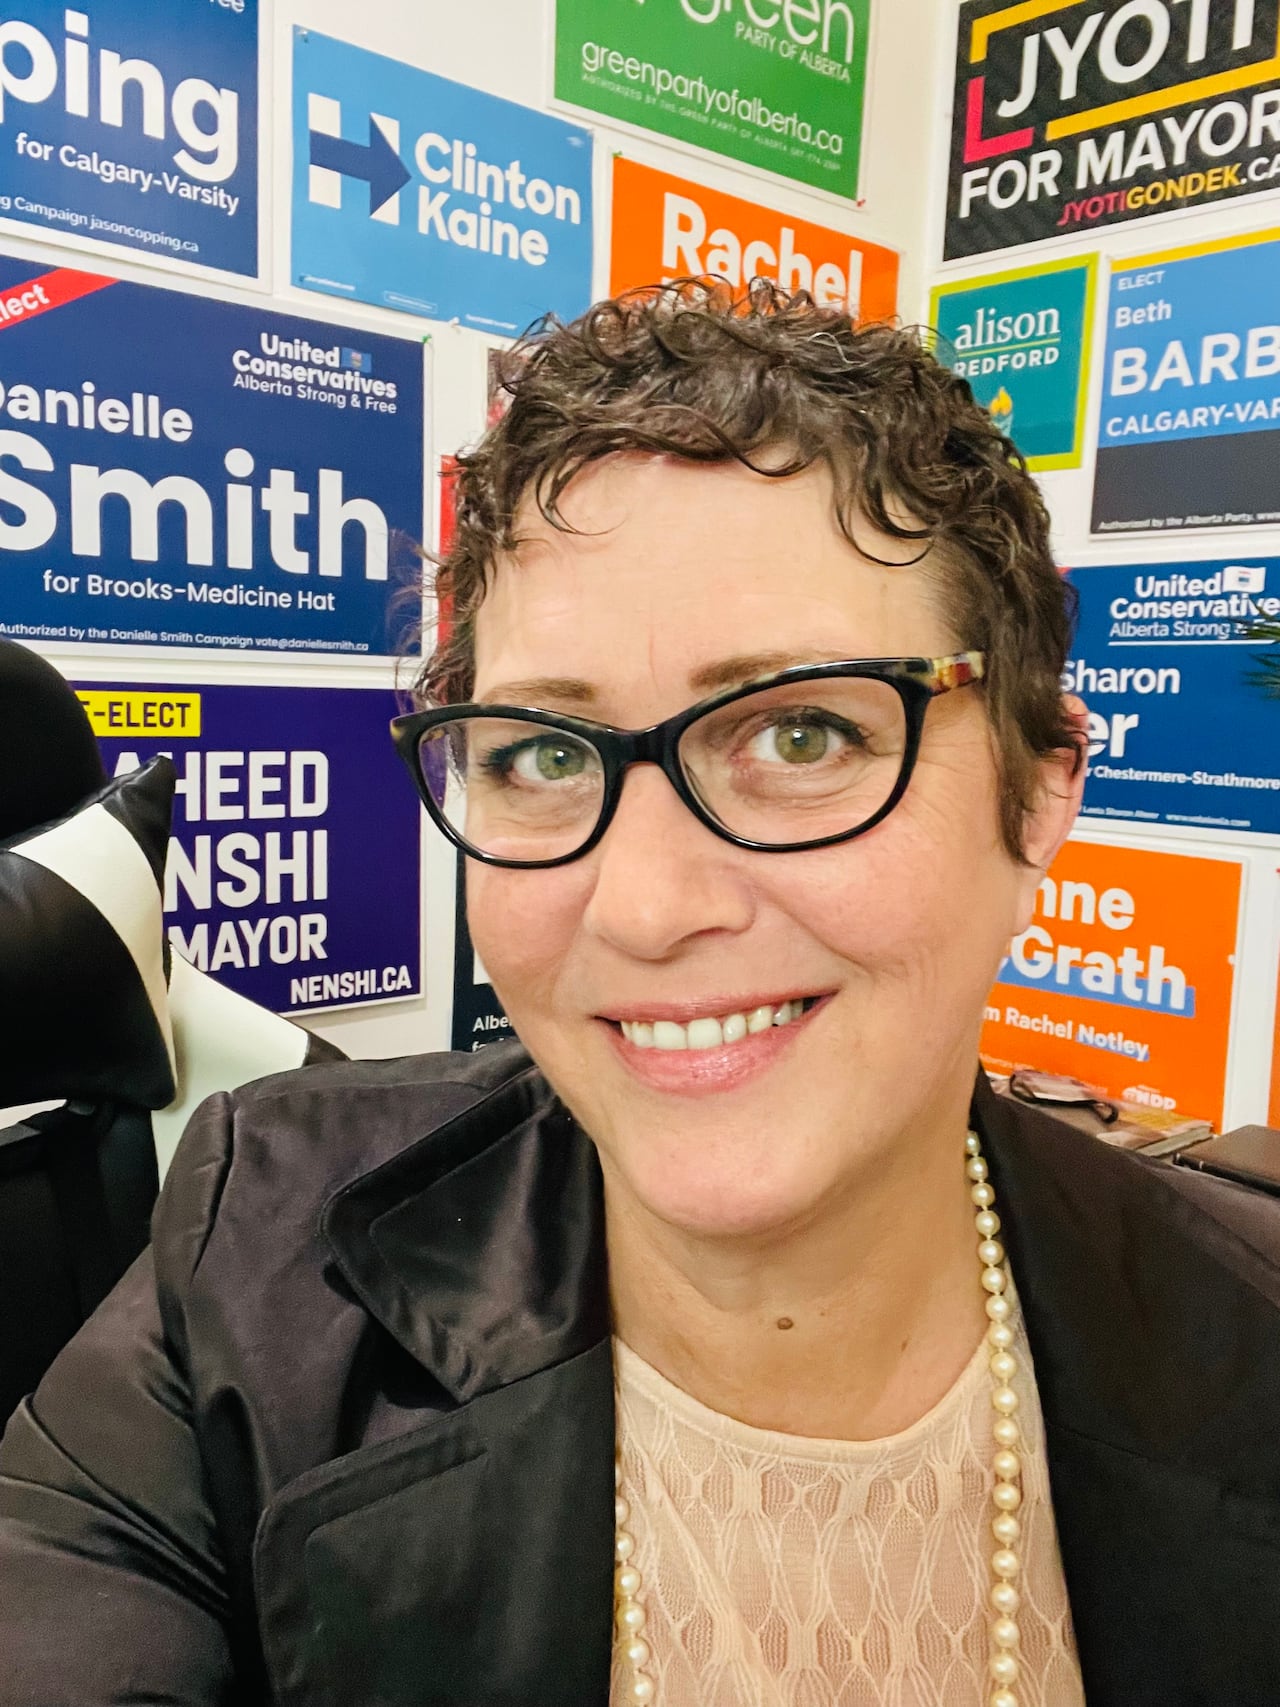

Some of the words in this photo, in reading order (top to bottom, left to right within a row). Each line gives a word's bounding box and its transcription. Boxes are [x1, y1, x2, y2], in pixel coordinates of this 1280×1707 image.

[735, 21, 776, 52] PARTY
[779, 40, 798, 60] OF
[799, 50, 851, 84] ALBERTA
[996, 0, 1256, 118] JYOTI
[581, 41, 843, 156] greenpartyofalberta.ca
[16, 132, 54, 161] for
[59, 145, 240, 217] Calgary-Varsity
[958, 149, 1063, 219] FOR
[1075, 90, 1280, 190] MAYOR
[414, 131, 581, 226] Clinton
[14, 196, 89, 227] Campaign
[89, 214, 200, 253] jasoncopping.ca
[418, 184, 550, 267] Kaine
[661, 191, 863, 320] Rachel
[1117, 270, 1166, 291] ELECT
[0, 283, 50, 323] lect
[1114, 300, 1173, 329] Beth
[259, 332, 341, 369] United
[954, 307, 1061, 351] alison
[231, 350, 398, 399] Conservatives
[953, 347, 1060, 378] REDFORD
[0, 381, 194, 443] anielle
[232, 373, 294, 398] Alberta
[296, 383, 347, 409] Strong
[350, 393, 362, 409] &
[364, 396, 398, 414] Free
[0, 429, 389, 582] Smith
[44, 568, 80, 594] for
[87, 574, 293, 610] Brooks-Medicine
[297, 590, 336, 612] Hat
[1135, 571, 1221, 598] United
[0, 622, 67, 637] Authorized
[69, 626, 85, 641] by
[88, 627, 108, 639] the
[110, 628, 157, 642] Danielle
[160, 631, 193, 643] Smith
[195, 633, 253, 649] Campaign
[1108, 621, 1171, 638] Alberta
[1172, 621, 1231, 640] Strong
[83, 698, 191, 728] -ELECT
[1093, 765, 1280, 791] Chestermere-Strathmore
[290, 965, 412, 1005] NENSHI.CA
[1005, 1007, 1073, 1040] Rachel
[1077, 1024, 1150, 1062] Notley
[1136, 1091, 1177, 1111] NDP
